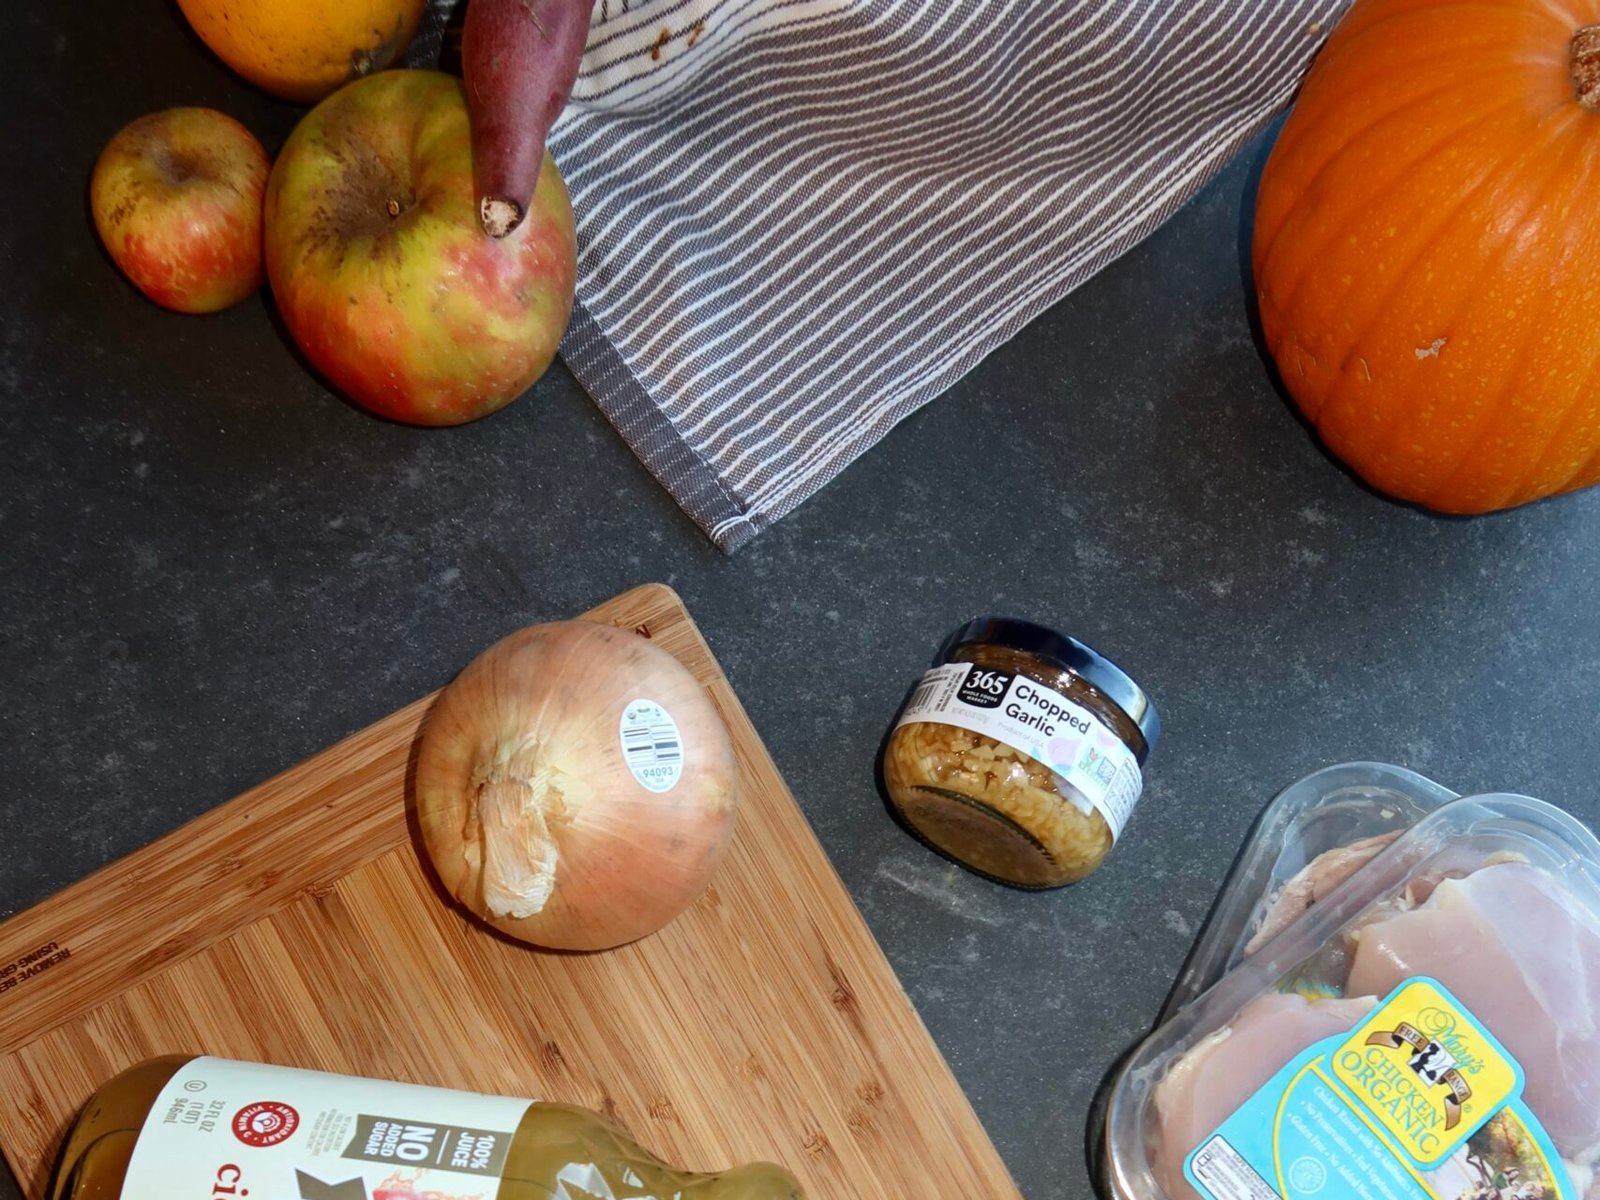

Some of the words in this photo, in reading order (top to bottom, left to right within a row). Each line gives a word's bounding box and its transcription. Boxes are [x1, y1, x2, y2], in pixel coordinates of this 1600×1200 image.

[966, 670, 1009, 694] 365
[980, 694, 998, 702] FOODS
[967, 696, 987, 704] MARKET
[1016, 684, 1091, 735] Chopped
[1006, 703, 1055, 737] Garlic
[643, 766, 673, 777] 94093
[17, 948, 71, 982] REMOVE
[18, 942, 58, 968] USING
[1399, 1026, 1426, 1046] FREE
[1417, 1007, 1483, 1075] Mary's
[1367, 1047, 1444, 1129] CHICKEN
[1446, 1071, 1467, 1099] RANGE
[164, 1098, 188, 1123] 946mL
[181, 1110, 200, 1124] QT)
[204, 1110, 220, 1118] FL
[210, 1100, 225, 1109] 32
[238, 1106, 263, 1130] VITAMIN
[1341, 1050, 1438, 1155] ORGANIC
[199, 1121, 214, 1132] OZ
[263, 1107, 294, 1143] ANTIOXIDANT
[364, 1122, 388, 1155] SUGAR
[380, 1123, 403, 1156] ADDED
[1314, 1087, 1341, 1113] Chicken
[1338, 1112, 1360, 1133] Raised
[1357, 1133, 1374, 1148] with
[1371, 1147, 1383, 1157] No
[1381, 1159, 1412, 1190] Antibiotics
[397, 1126, 436, 1160] NO
[452, 1132, 475, 1167] JUICE
[470, 1136, 495, 1168] 100%
[1291, 1116, 1314, 1138] Gluten
[1311, 1137, 1326, 1151] Free
[1338, 1166, 1360, 1187] Added
[1305, 1104, 1316, 1115] No
[1367, 1168, 1398, 1200] Vegetarian
